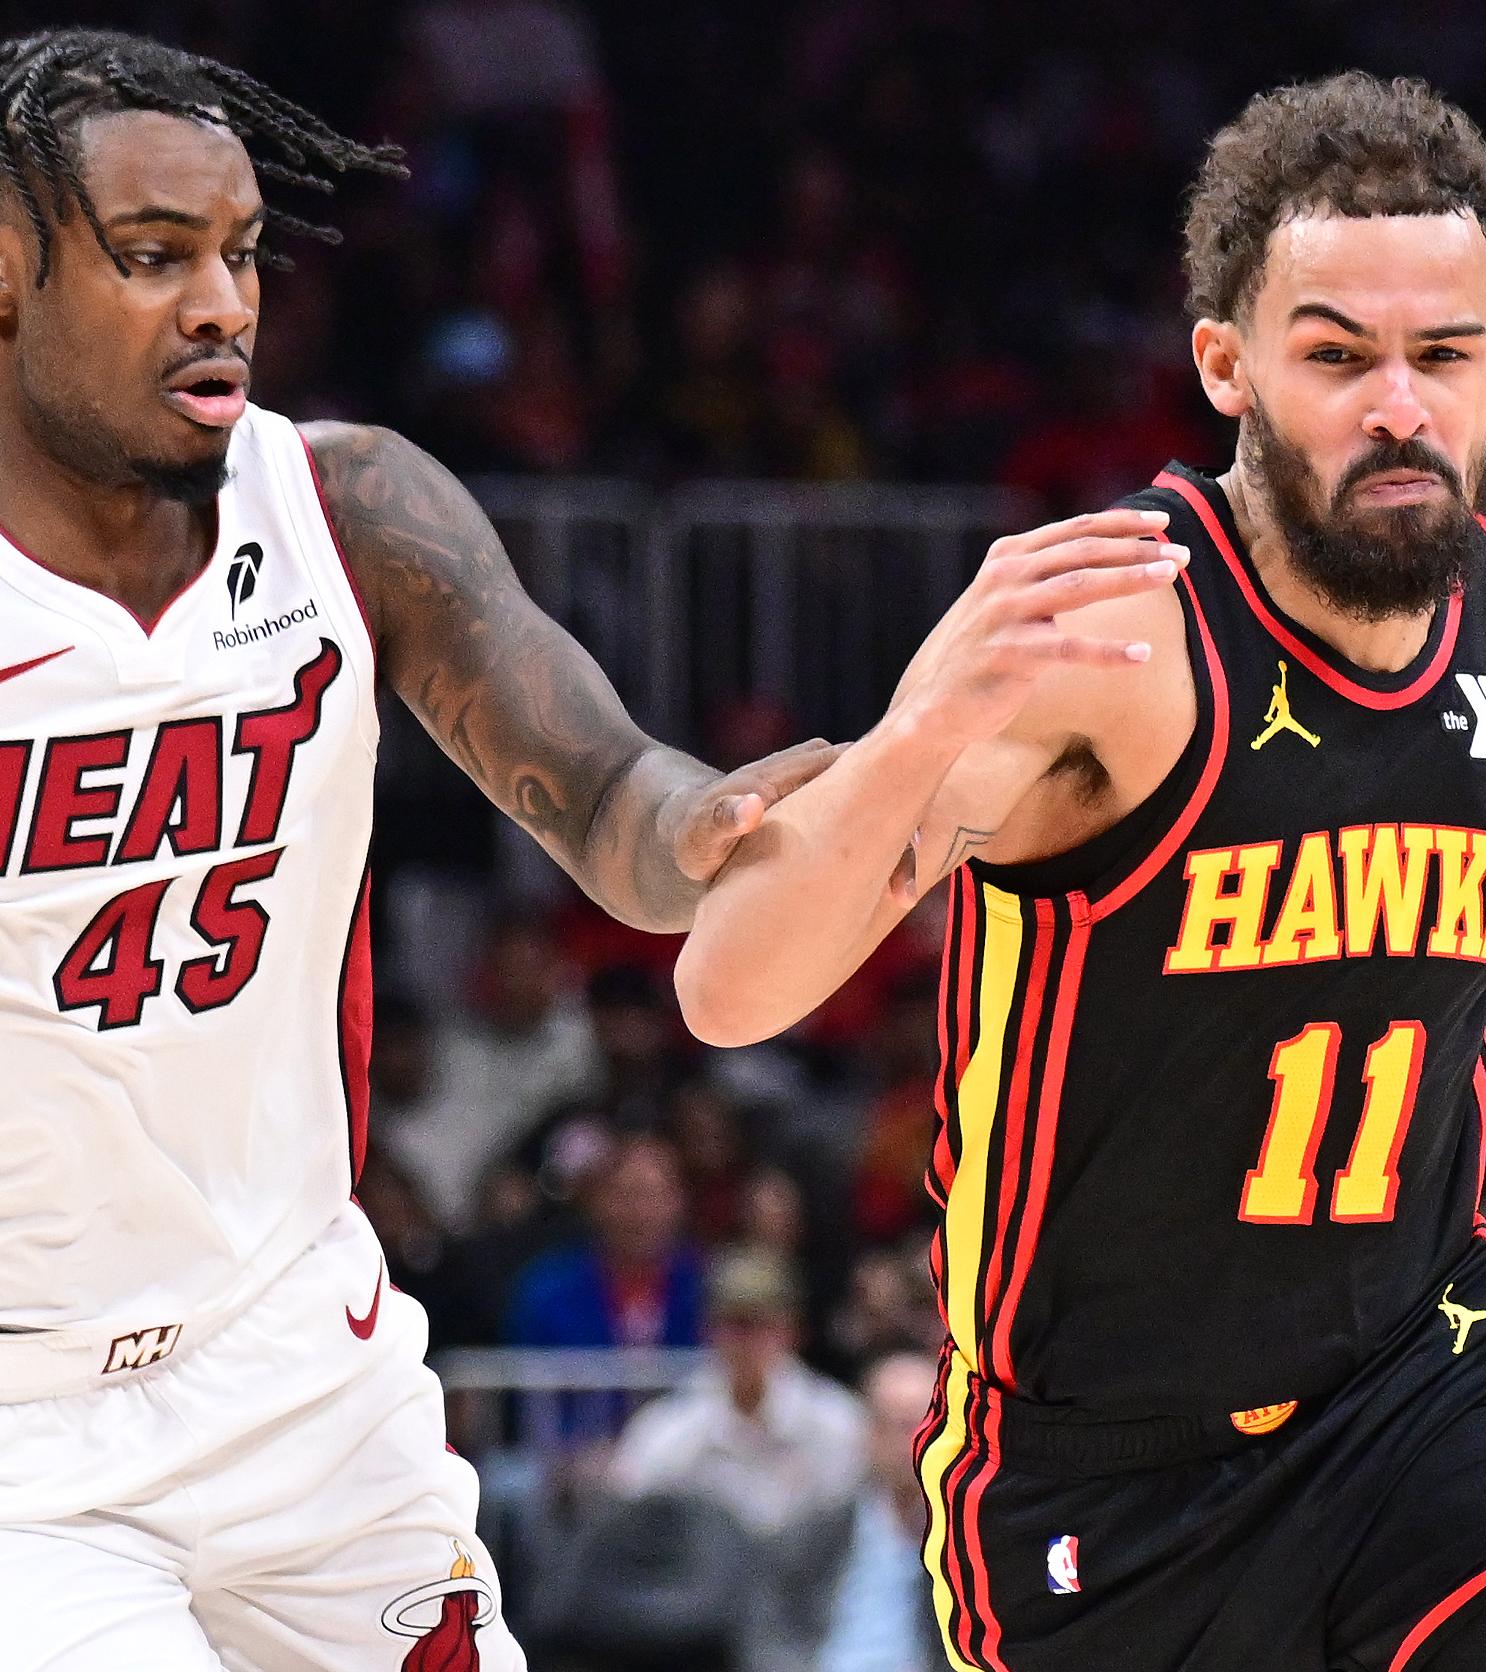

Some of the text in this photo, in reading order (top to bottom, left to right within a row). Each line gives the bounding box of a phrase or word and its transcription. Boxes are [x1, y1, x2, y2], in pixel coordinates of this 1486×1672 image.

[213, 598, 318, 650] Robinhood
[1443, 710, 1469, 731] the
[52, 846, 287, 1032] 45
[1237, 1019, 1427, 1226] 11
[101, 1323, 184, 1375] MH
